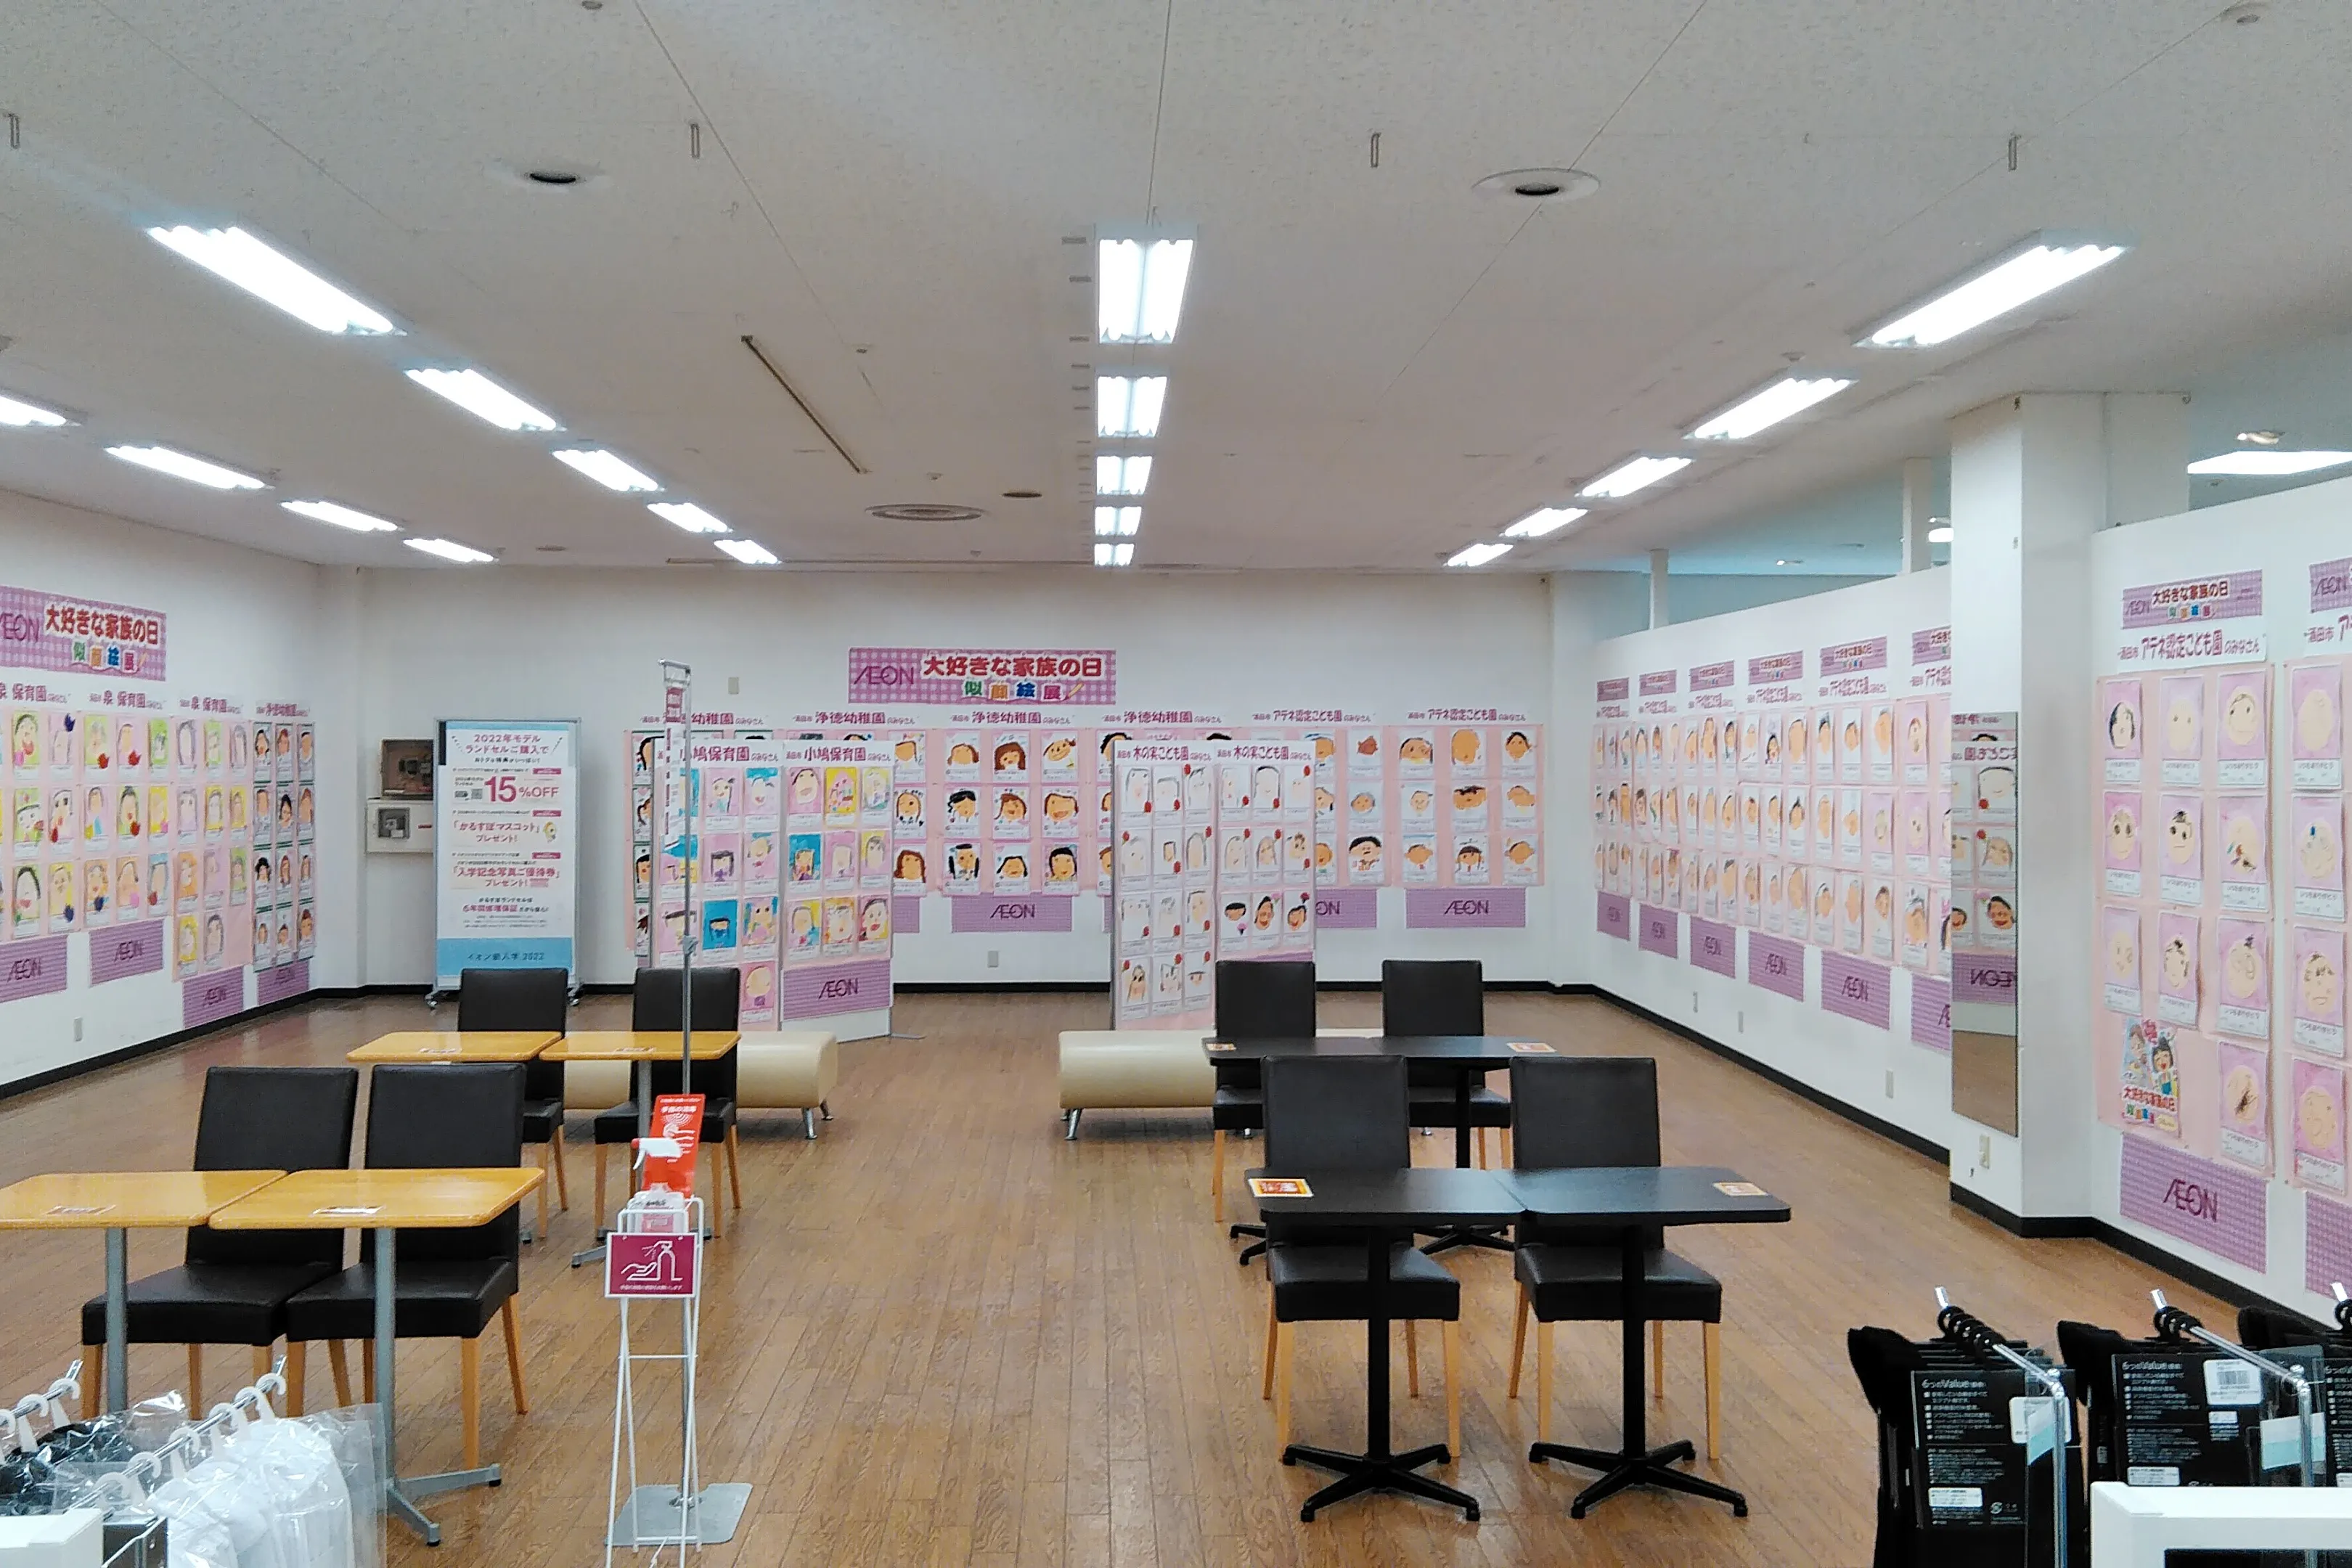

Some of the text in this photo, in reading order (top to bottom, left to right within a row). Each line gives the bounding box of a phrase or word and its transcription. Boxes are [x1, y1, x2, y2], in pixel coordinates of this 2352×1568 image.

[46, 604, 158, 645] 大好きな家族の日
[923, 656, 1103, 677] 大好きな家族の日
[474, 734, 542, 743] 2022年モデル
[465, 745, 550, 754] ランドセルご購入で
